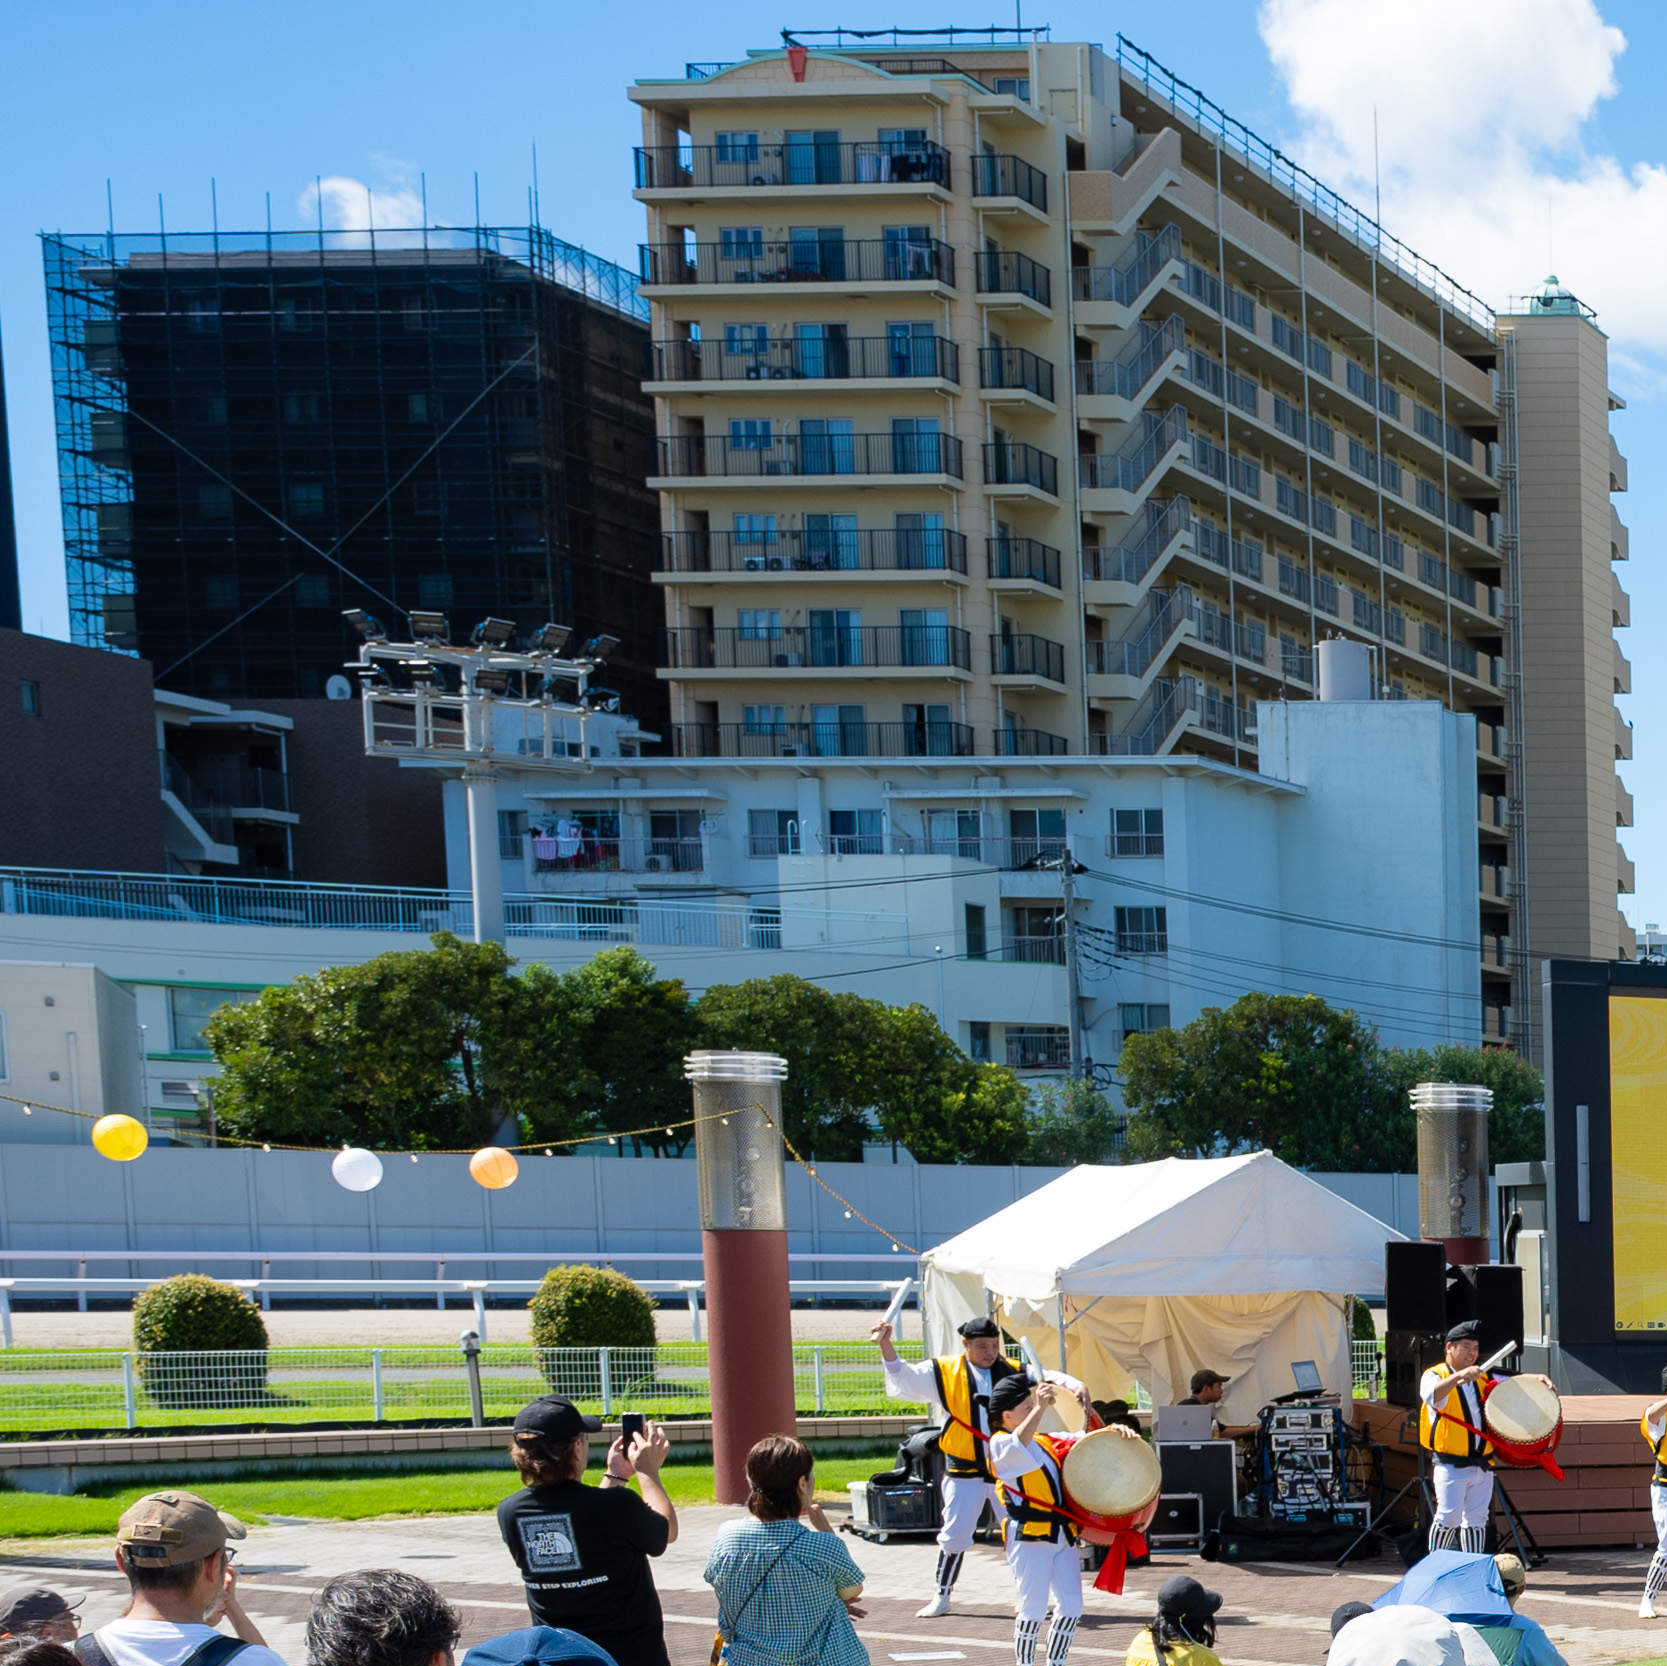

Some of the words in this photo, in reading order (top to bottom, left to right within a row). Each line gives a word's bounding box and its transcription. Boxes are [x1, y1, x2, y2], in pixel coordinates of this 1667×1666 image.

[536, 1532, 554, 1540] THE
[526, 1540, 555, 1549] NORTH
[536, 1547, 557, 1556] FACE
[561, 1575, 609, 1589] EXPLORING
